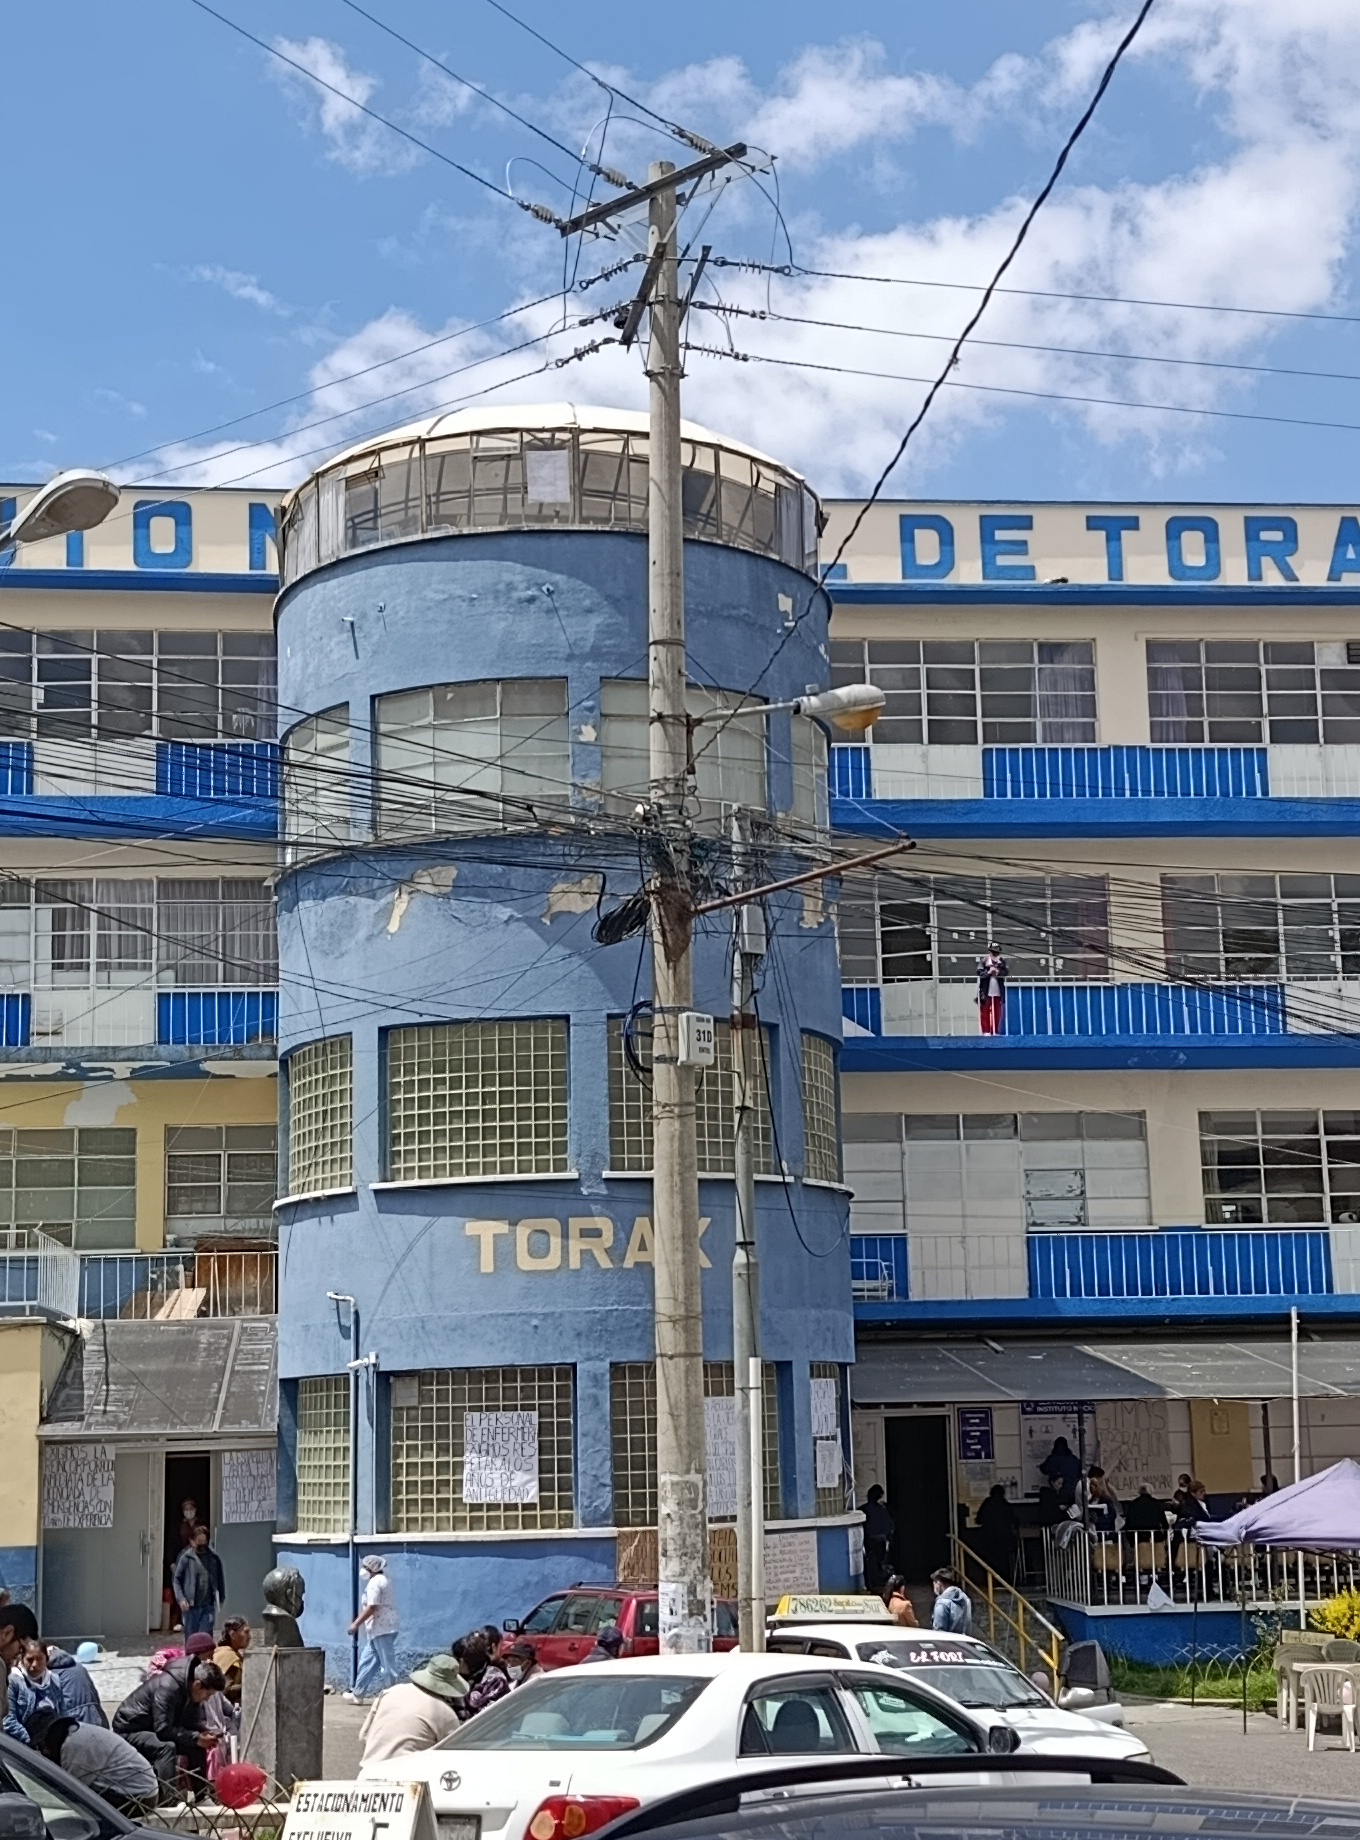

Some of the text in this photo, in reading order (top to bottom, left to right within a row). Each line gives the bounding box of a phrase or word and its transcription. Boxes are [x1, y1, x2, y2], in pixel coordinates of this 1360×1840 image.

[899, 513, 1036, 581] DE
[465, 1216, 712, 1274] TORA
[479, 1412, 537, 1427] PERSONAL
[295, 1792, 405, 1813] ESTACIONAMIENTO
